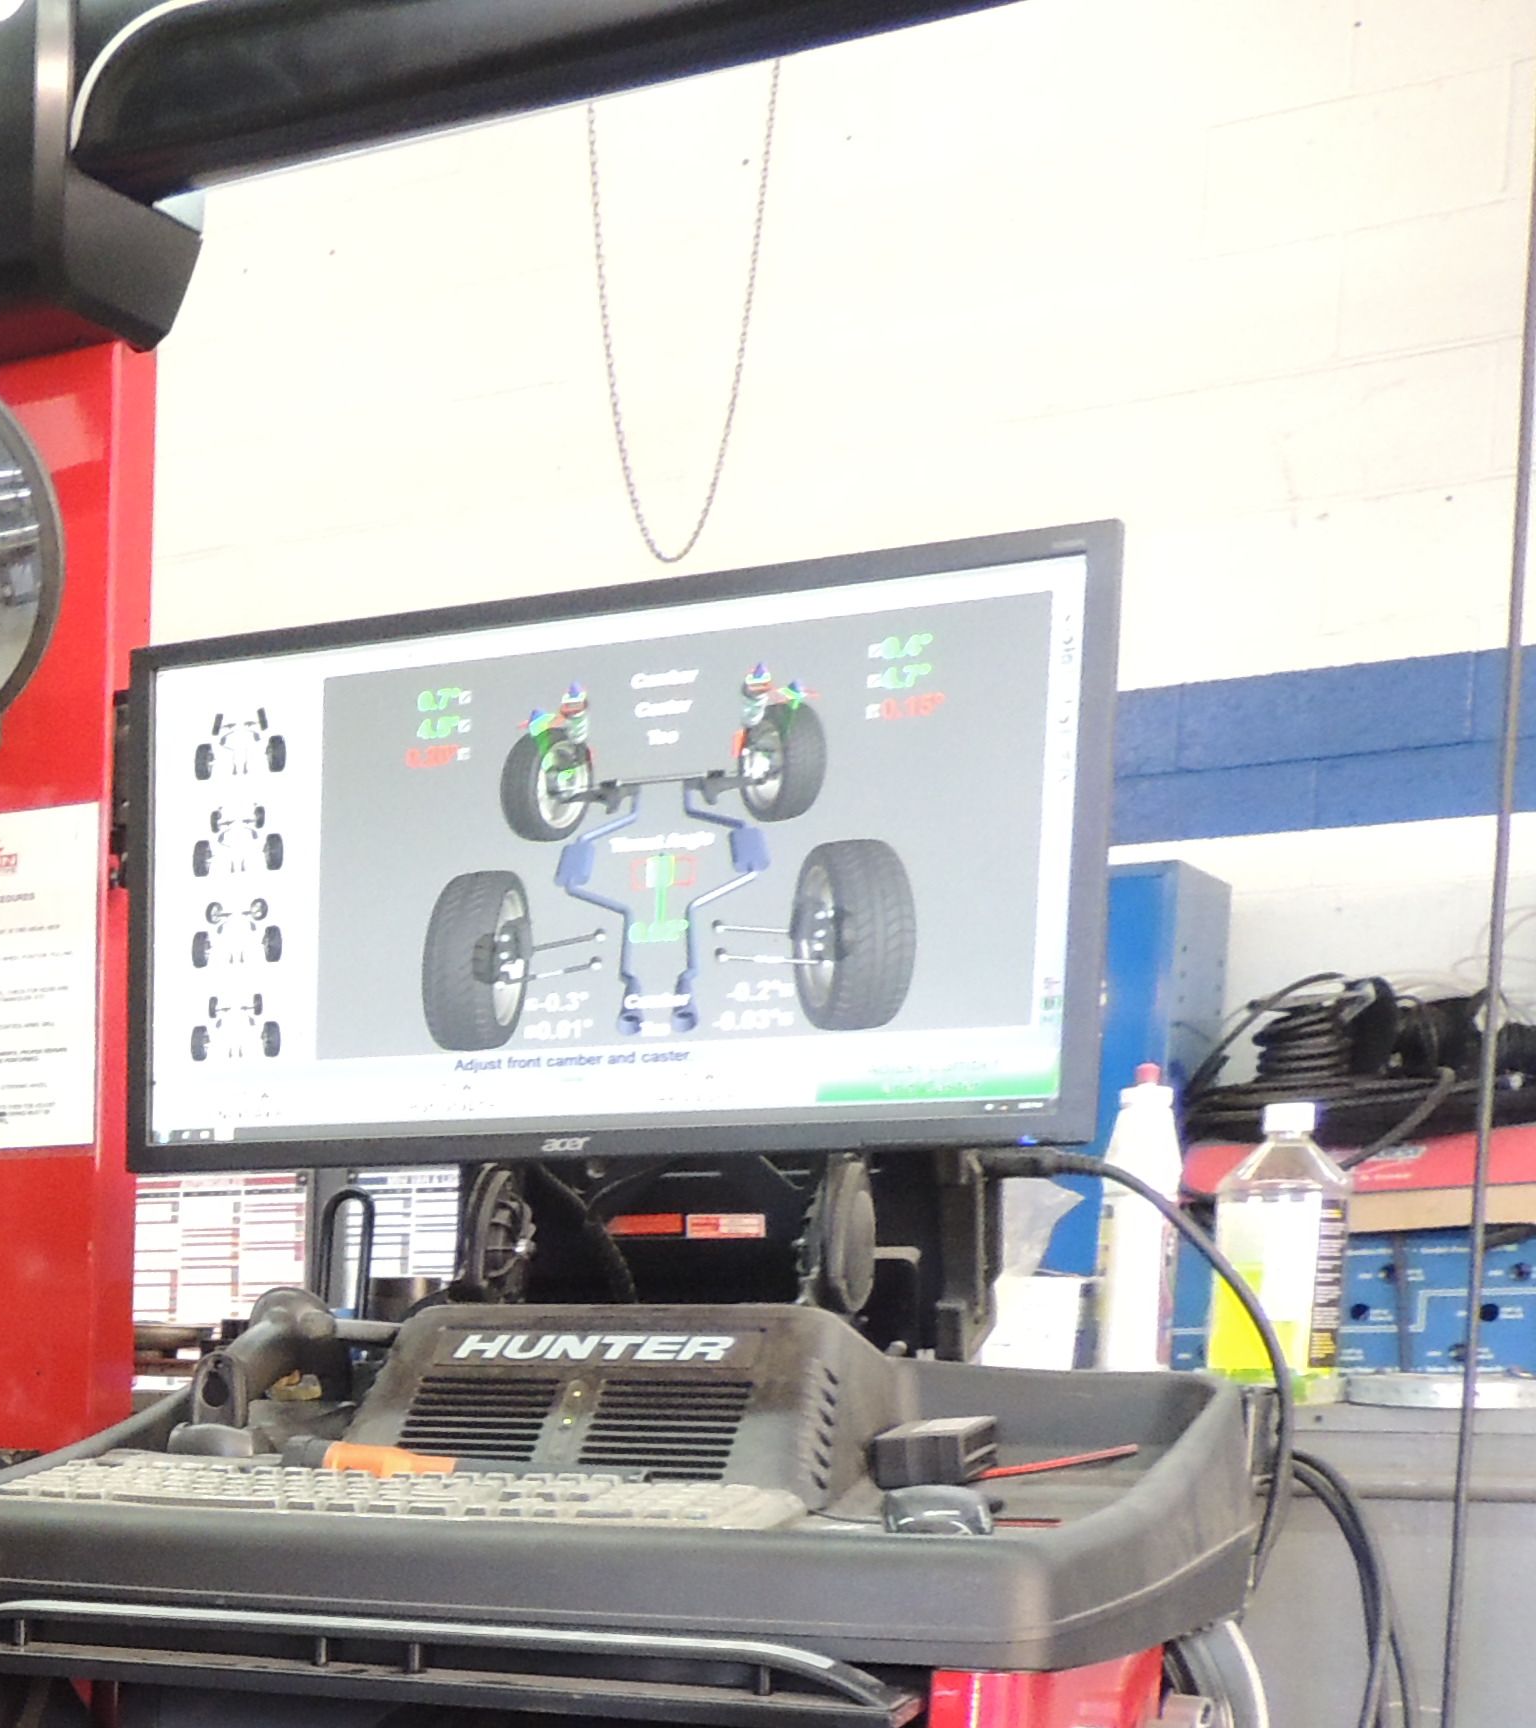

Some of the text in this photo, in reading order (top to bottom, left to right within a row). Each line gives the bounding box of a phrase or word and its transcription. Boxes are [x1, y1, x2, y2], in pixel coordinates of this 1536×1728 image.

[454, 1050, 690, 1073] Adjust front camber and caster
[541, 1136, 591, 1152] acer
[452, 1333, 735, 1362] HUNTER
